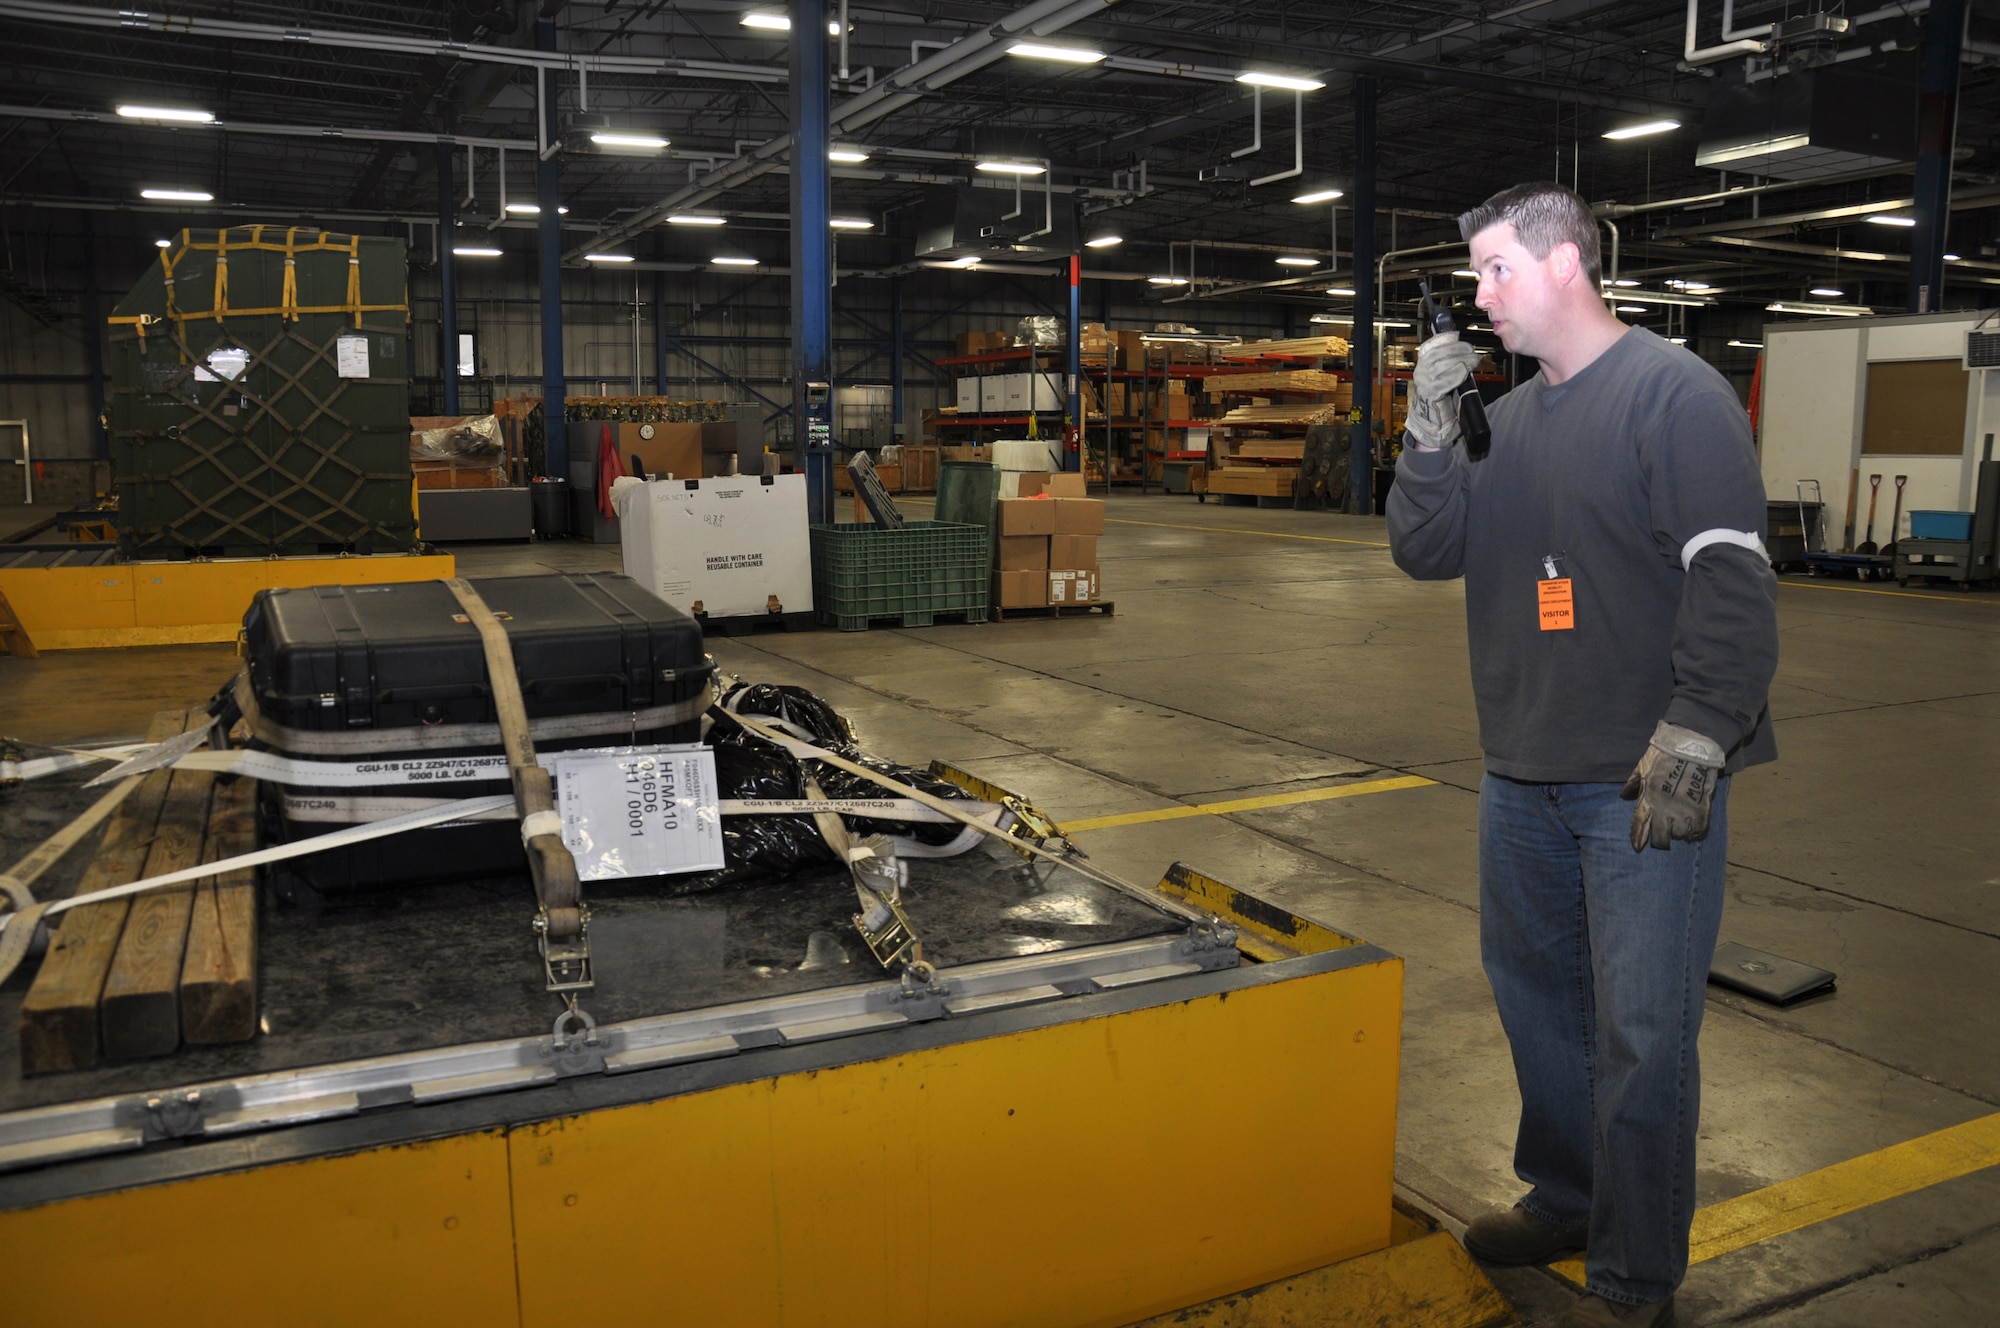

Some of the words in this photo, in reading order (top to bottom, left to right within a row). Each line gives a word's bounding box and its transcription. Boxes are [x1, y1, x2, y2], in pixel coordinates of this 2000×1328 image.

[730, 554, 746, 562] WITH
[707, 562, 733, 571] REUSABLE
[734, 560, 764, 569] CONTAINER
[1542, 610, 1570, 618] VISITOR
[356, 763, 399, 773] CGU-1/B
[402, 762, 422, 771] CL2
[625, 763, 641, 783] H1
[408, 771, 432, 780] 5000
[435, 770, 451, 779] LB.
[454, 769, 477, 778] CAP.
[641, 763, 658, 813] 046D6
[659, 761, 678, 830] HFMA10
[628, 800, 644, 837] 0001
